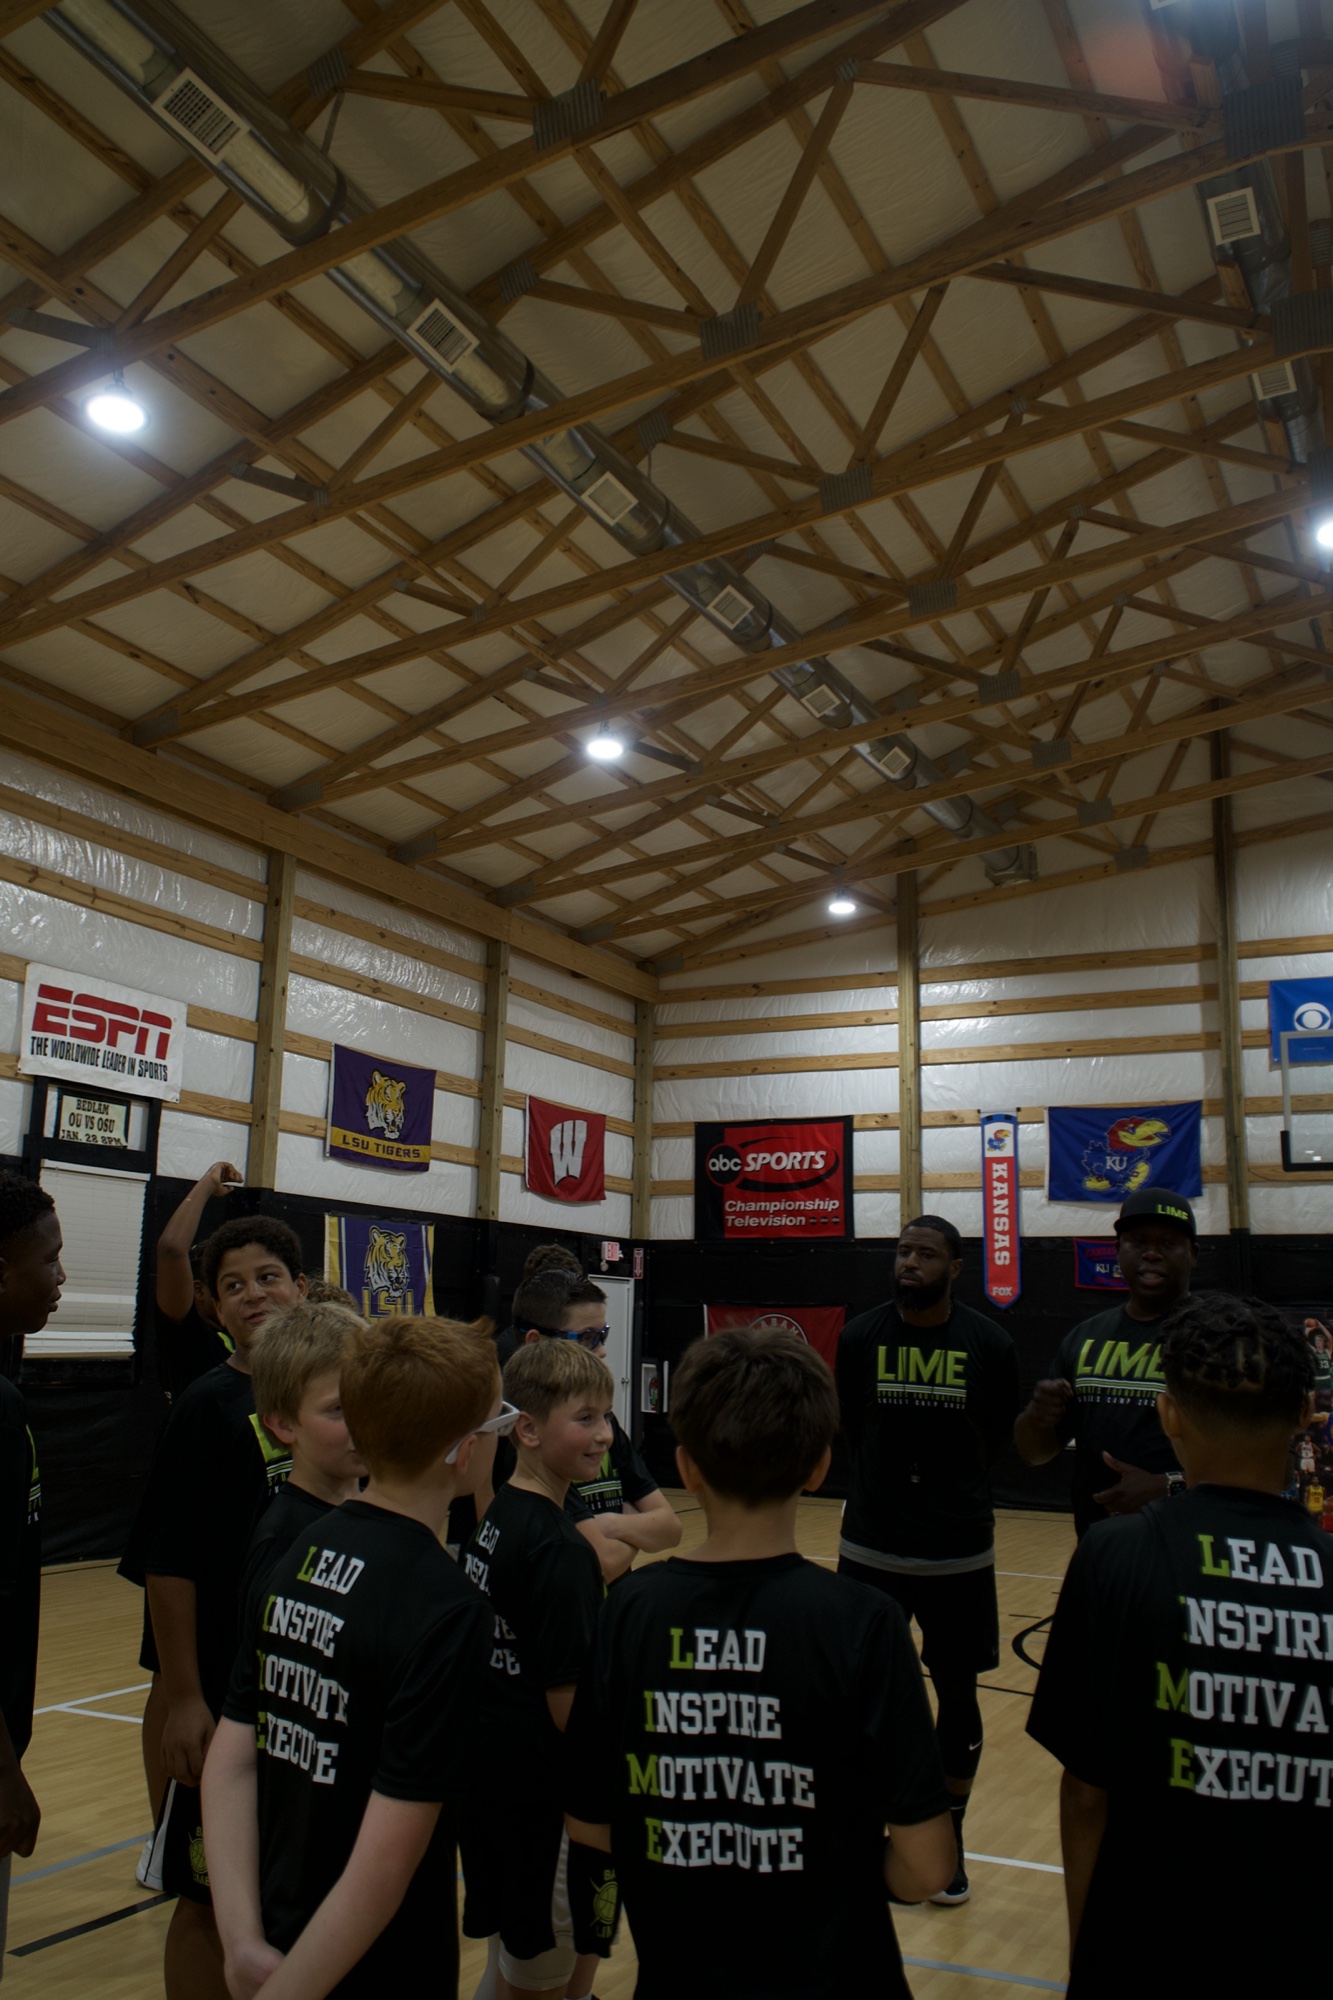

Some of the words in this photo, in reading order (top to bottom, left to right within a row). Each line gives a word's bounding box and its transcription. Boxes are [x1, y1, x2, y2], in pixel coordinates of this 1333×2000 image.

[32, 983, 172, 1060] ESPN
[31, 1036, 48, 1056] THE
[51, 1039, 100, 1067] WORLDWIDE
[102, 1050, 126, 1072] LEADER
[127, 1057, 136, 1075] IN
[138, 1059, 168, 1081] SPORTS
[69, 1112, 82, 1127] OU
[85, 1115, 95, 1129] VS
[97, 1117, 115, 1133] OSU
[76, 1099, 110, 1115] BEDLAM
[61, 1129, 82, 1141] JAN.
[342, 1134, 370, 1150] LSU
[374, 1143, 420, 1158] TIGERS
[549, 1119, 588, 1188] W
[708, 1154, 742, 1171] abc
[744, 1150, 827, 1172] SPORTS
[1105, 1156, 1128, 1172] KU
[725, 1197, 840, 1213] Championship
[725, 1214, 806, 1227] Television
[992, 1162, 1011, 1266] KANSAS
[1157, 1204, 1189, 1220] LIME
[362, 1286, 414, 1318] LSU
[992, 1286, 1013, 1296] FOX
[877, 1345, 969, 1386] LIME
[1076, 1338, 1166, 1379] LIME
[1137, 1399, 1155, 1407] 202
[296, 1545, 366, 1595] LEAD
[1196, 1533, 1325, 1589] LEAD
[668, 1626, 768, 1673] LEAD
[643, 1689, 783, 1740] INSPIRE
[1154, 1660, 1333, 1734] MOTIVA
[257, 1711, 340, 1785] EXECUE
[626, 1752, 816, 1809] MOTIVATE
[644, 1816, 805, 1873] EXECUTE
